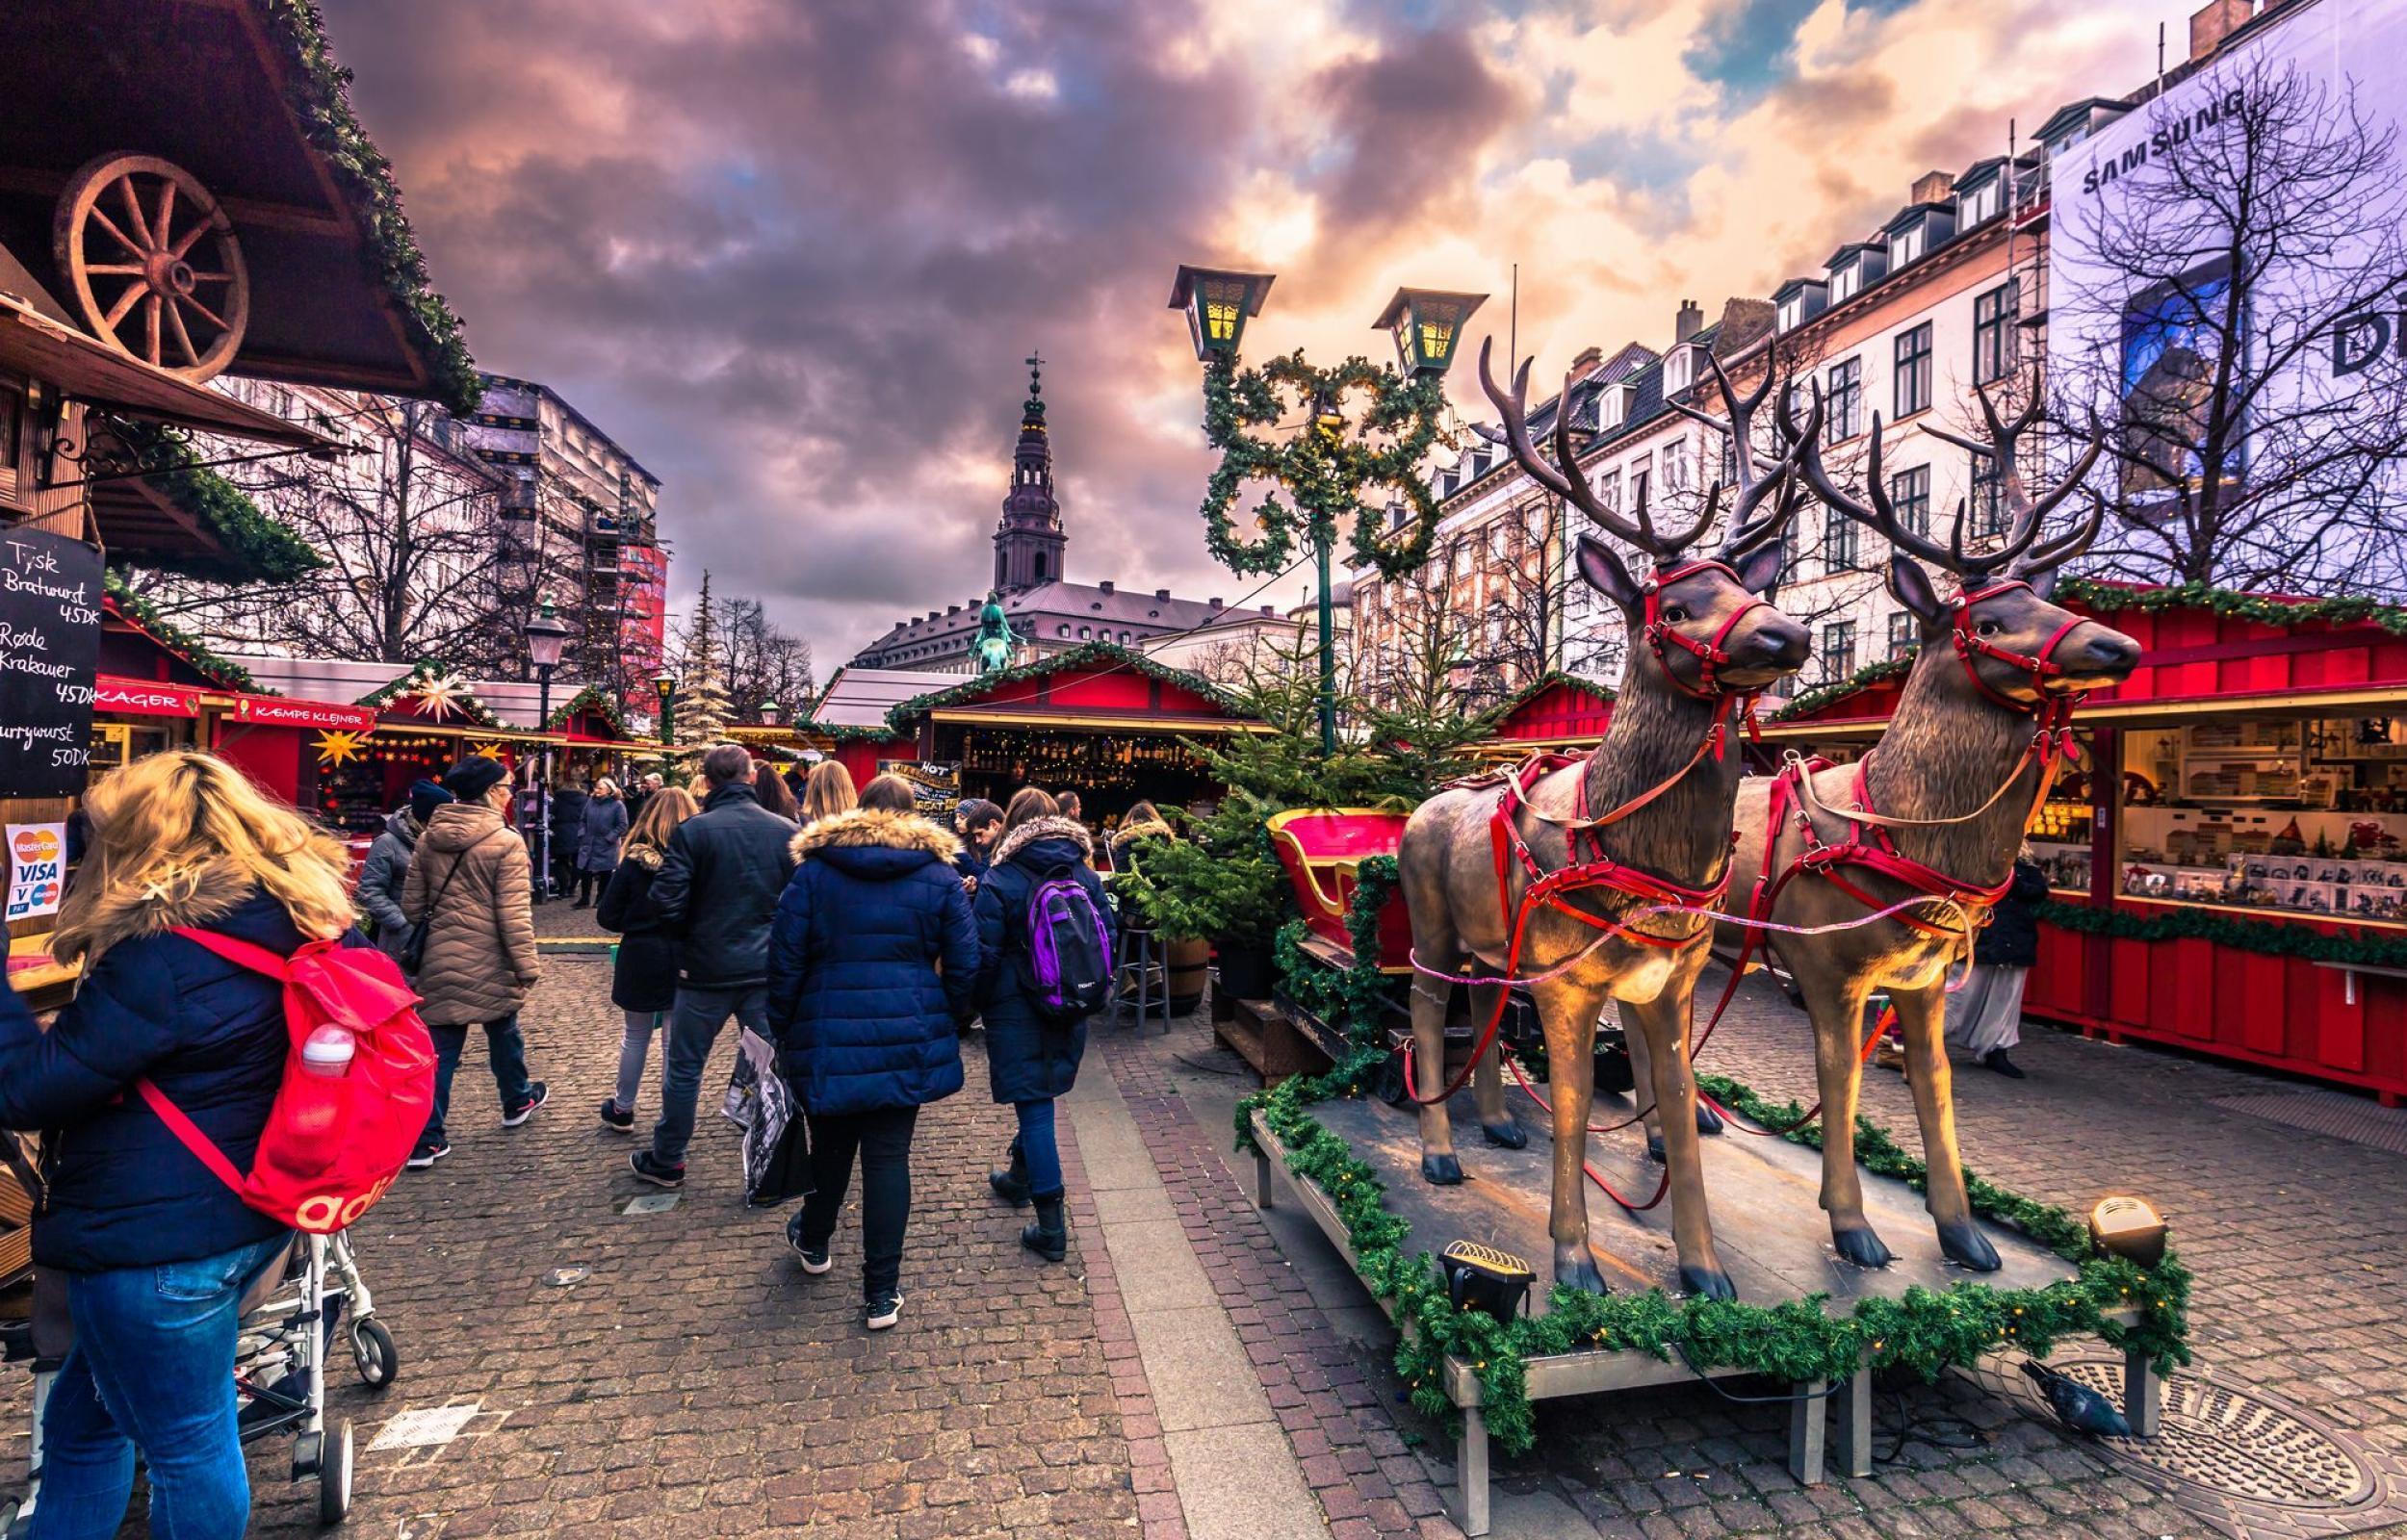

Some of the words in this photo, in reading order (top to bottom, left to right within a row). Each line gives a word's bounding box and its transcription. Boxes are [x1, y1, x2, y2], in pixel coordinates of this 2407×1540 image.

[2083, 90, 2244, 194] SAMSUNG
[6, 540, 61, 575] Tysk
[1, 568, 89, 605] Bratwurst
[60, 604, 100, 625] 45DK
[0, 622, 48, 651] Røde
[0, 650, 76, 680] Krakauer
[93, 690, 180, 708] KAGER
[255, 706, 310, 720] KÆMPE
[312, 712, 363, 726] KLEJNER
[0, 723, 74, 752] urrywurst
[51, 748, 91, 767] 50DK
[921, 761, 948, 776] HOT
[17, 862, 58, 883] VISA
[296, 1176, 390, 1229] adi
